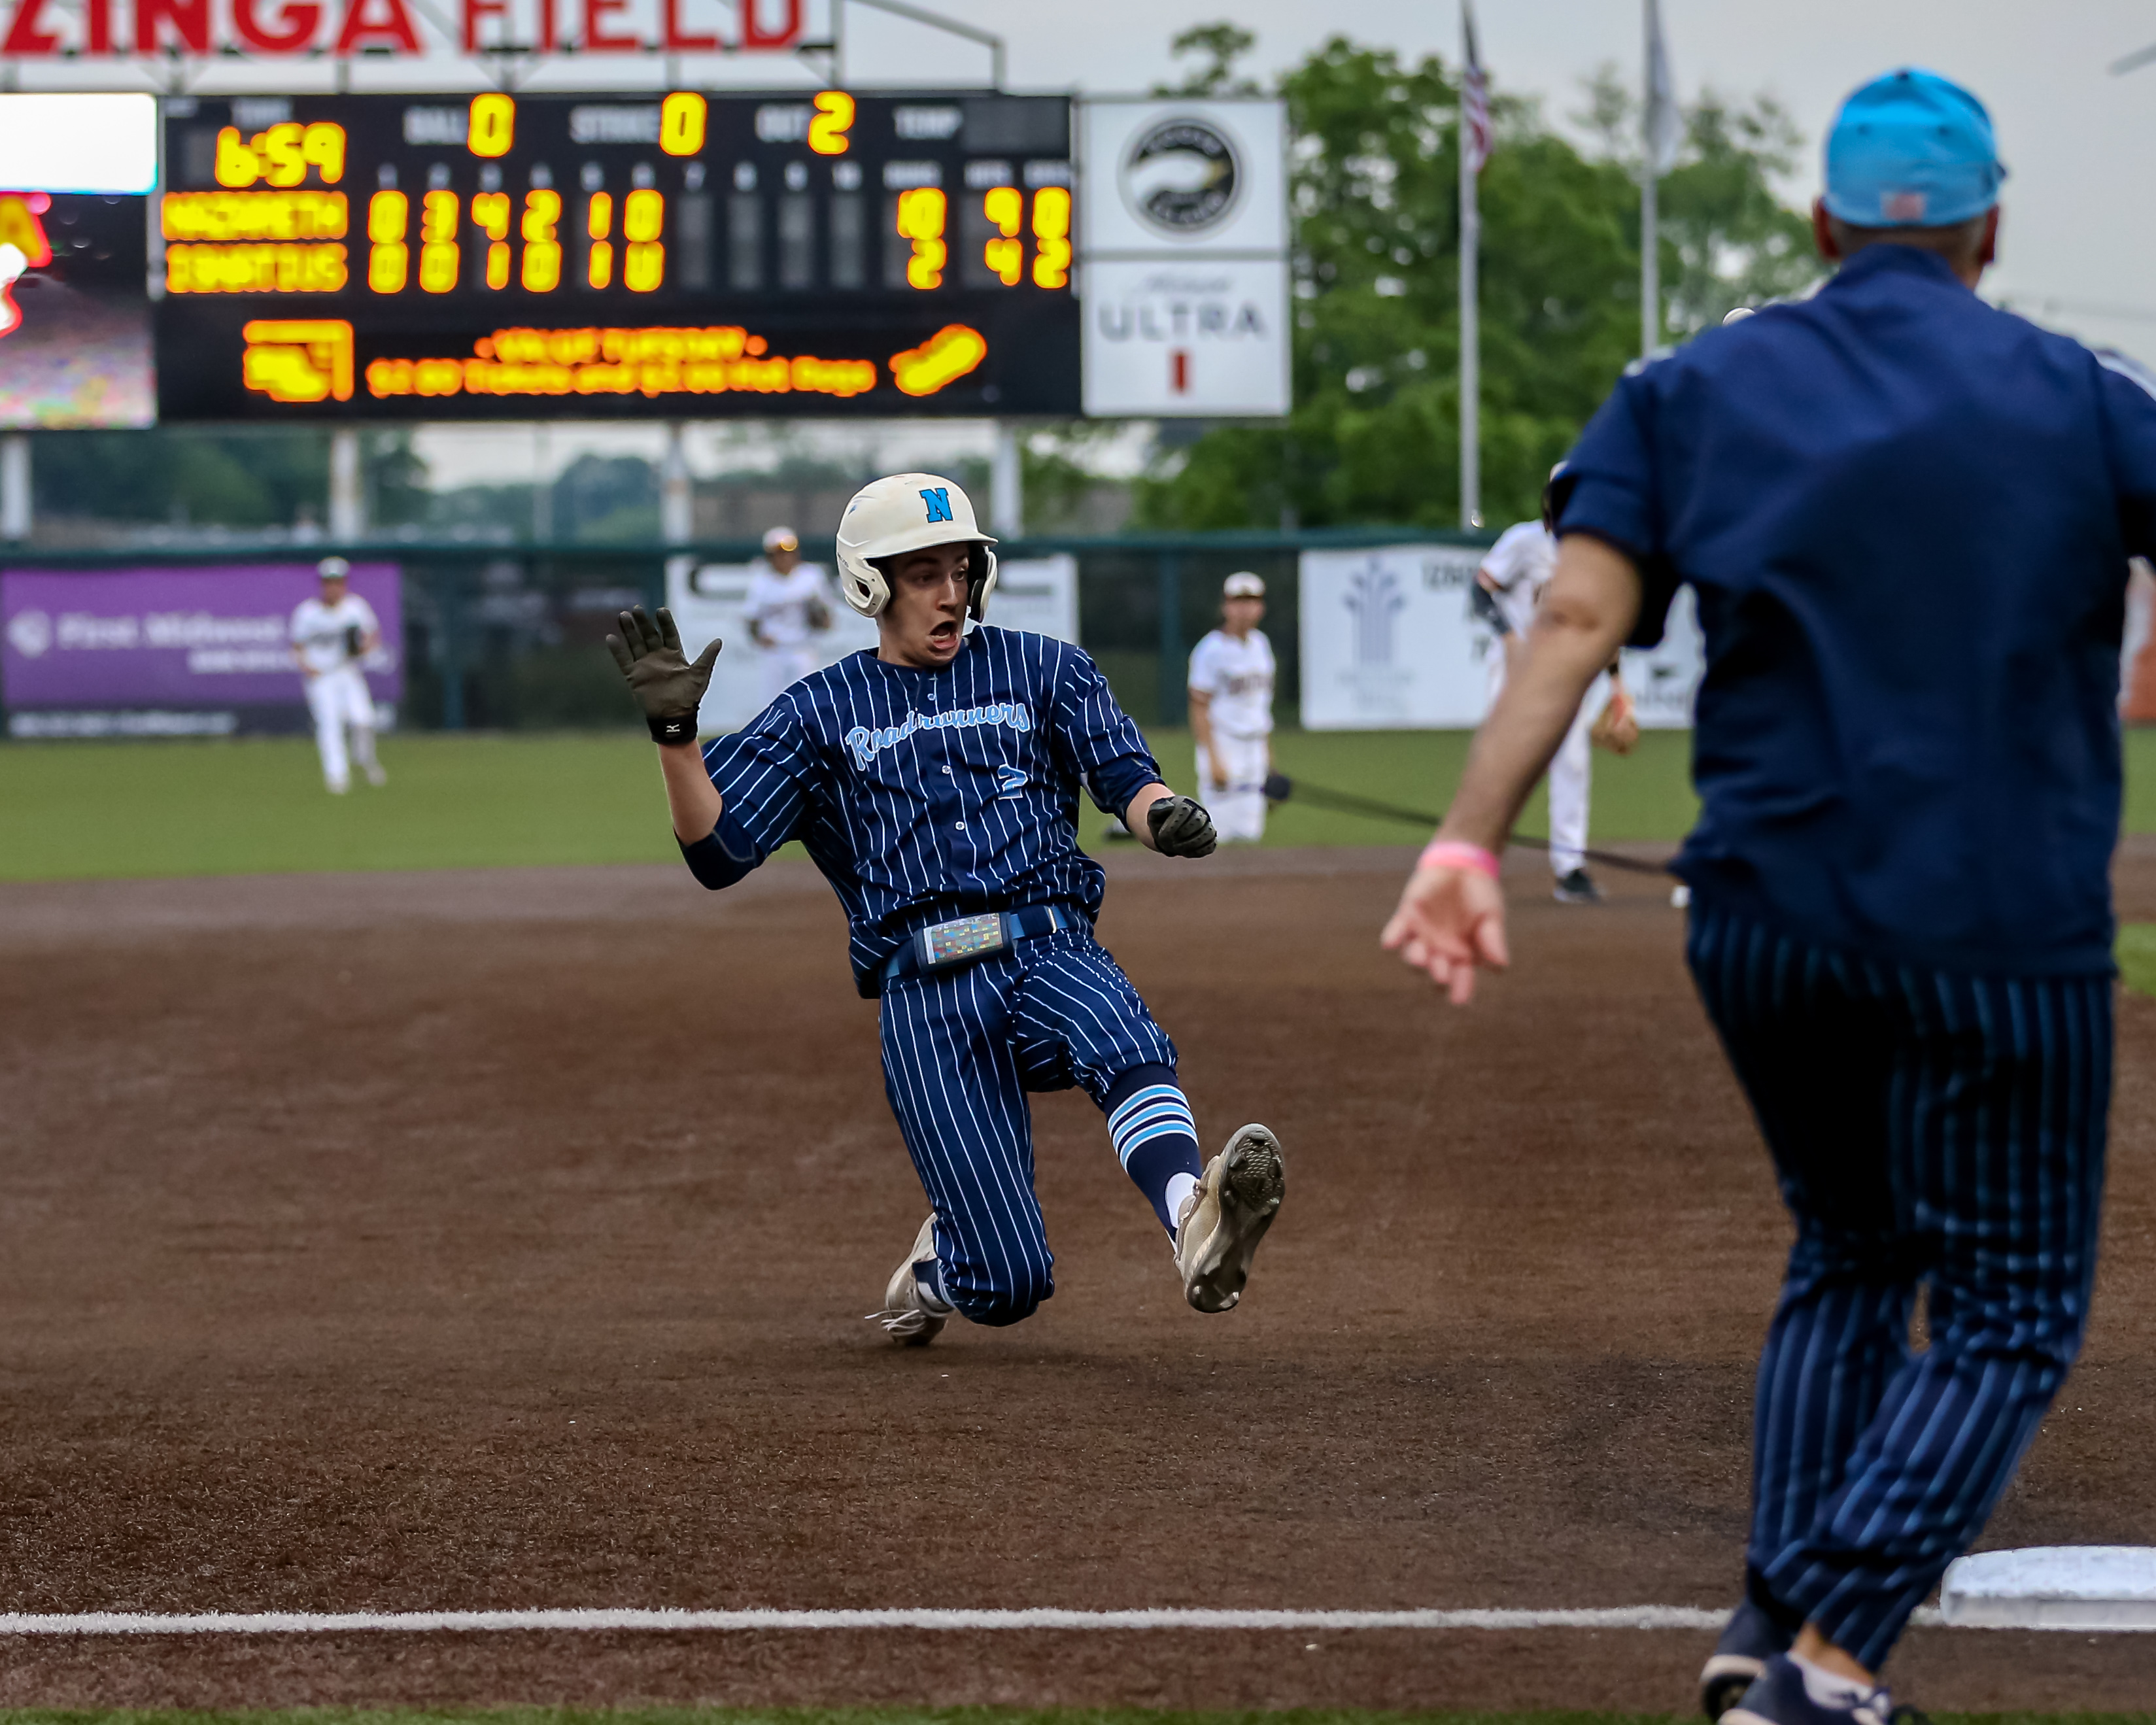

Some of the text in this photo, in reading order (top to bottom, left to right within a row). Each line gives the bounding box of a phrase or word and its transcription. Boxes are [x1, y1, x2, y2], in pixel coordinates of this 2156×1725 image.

[2, 0, 802, 52] ZINGA FIELD
[468, 93, 515, 158] 0
[660, 92, 706, 156] 0
[809, 92, 855, 155] 2
[215, 122, 346, 188] 6:59
[368, 190, 409, 241] 0
[420, 190, 459, 241] 3
[471, 192, 511, 241] 4
[521, 189, 562, 242] 2
[589, 191, 613, 241] 1
[624, 189, 664, 242] 0
[368, 240, 409, 294] 0
[419, 240, 460, 294] 0
[487, 240, 510, 291] 1
[521, 240, 562, 293] 0
[589, 239, 613, 290] 1
[906, 237, 948, 290] 2
[984, 237, 1023, 286] 4
[1032, 237, 1072, 289] 2
[1098, 302, 1269, 342] ULTRA
[919, 487, 953, 524] N
[845, 702, 1031, 772] Roadrunners
[997, 763, 1029, 800] 2
